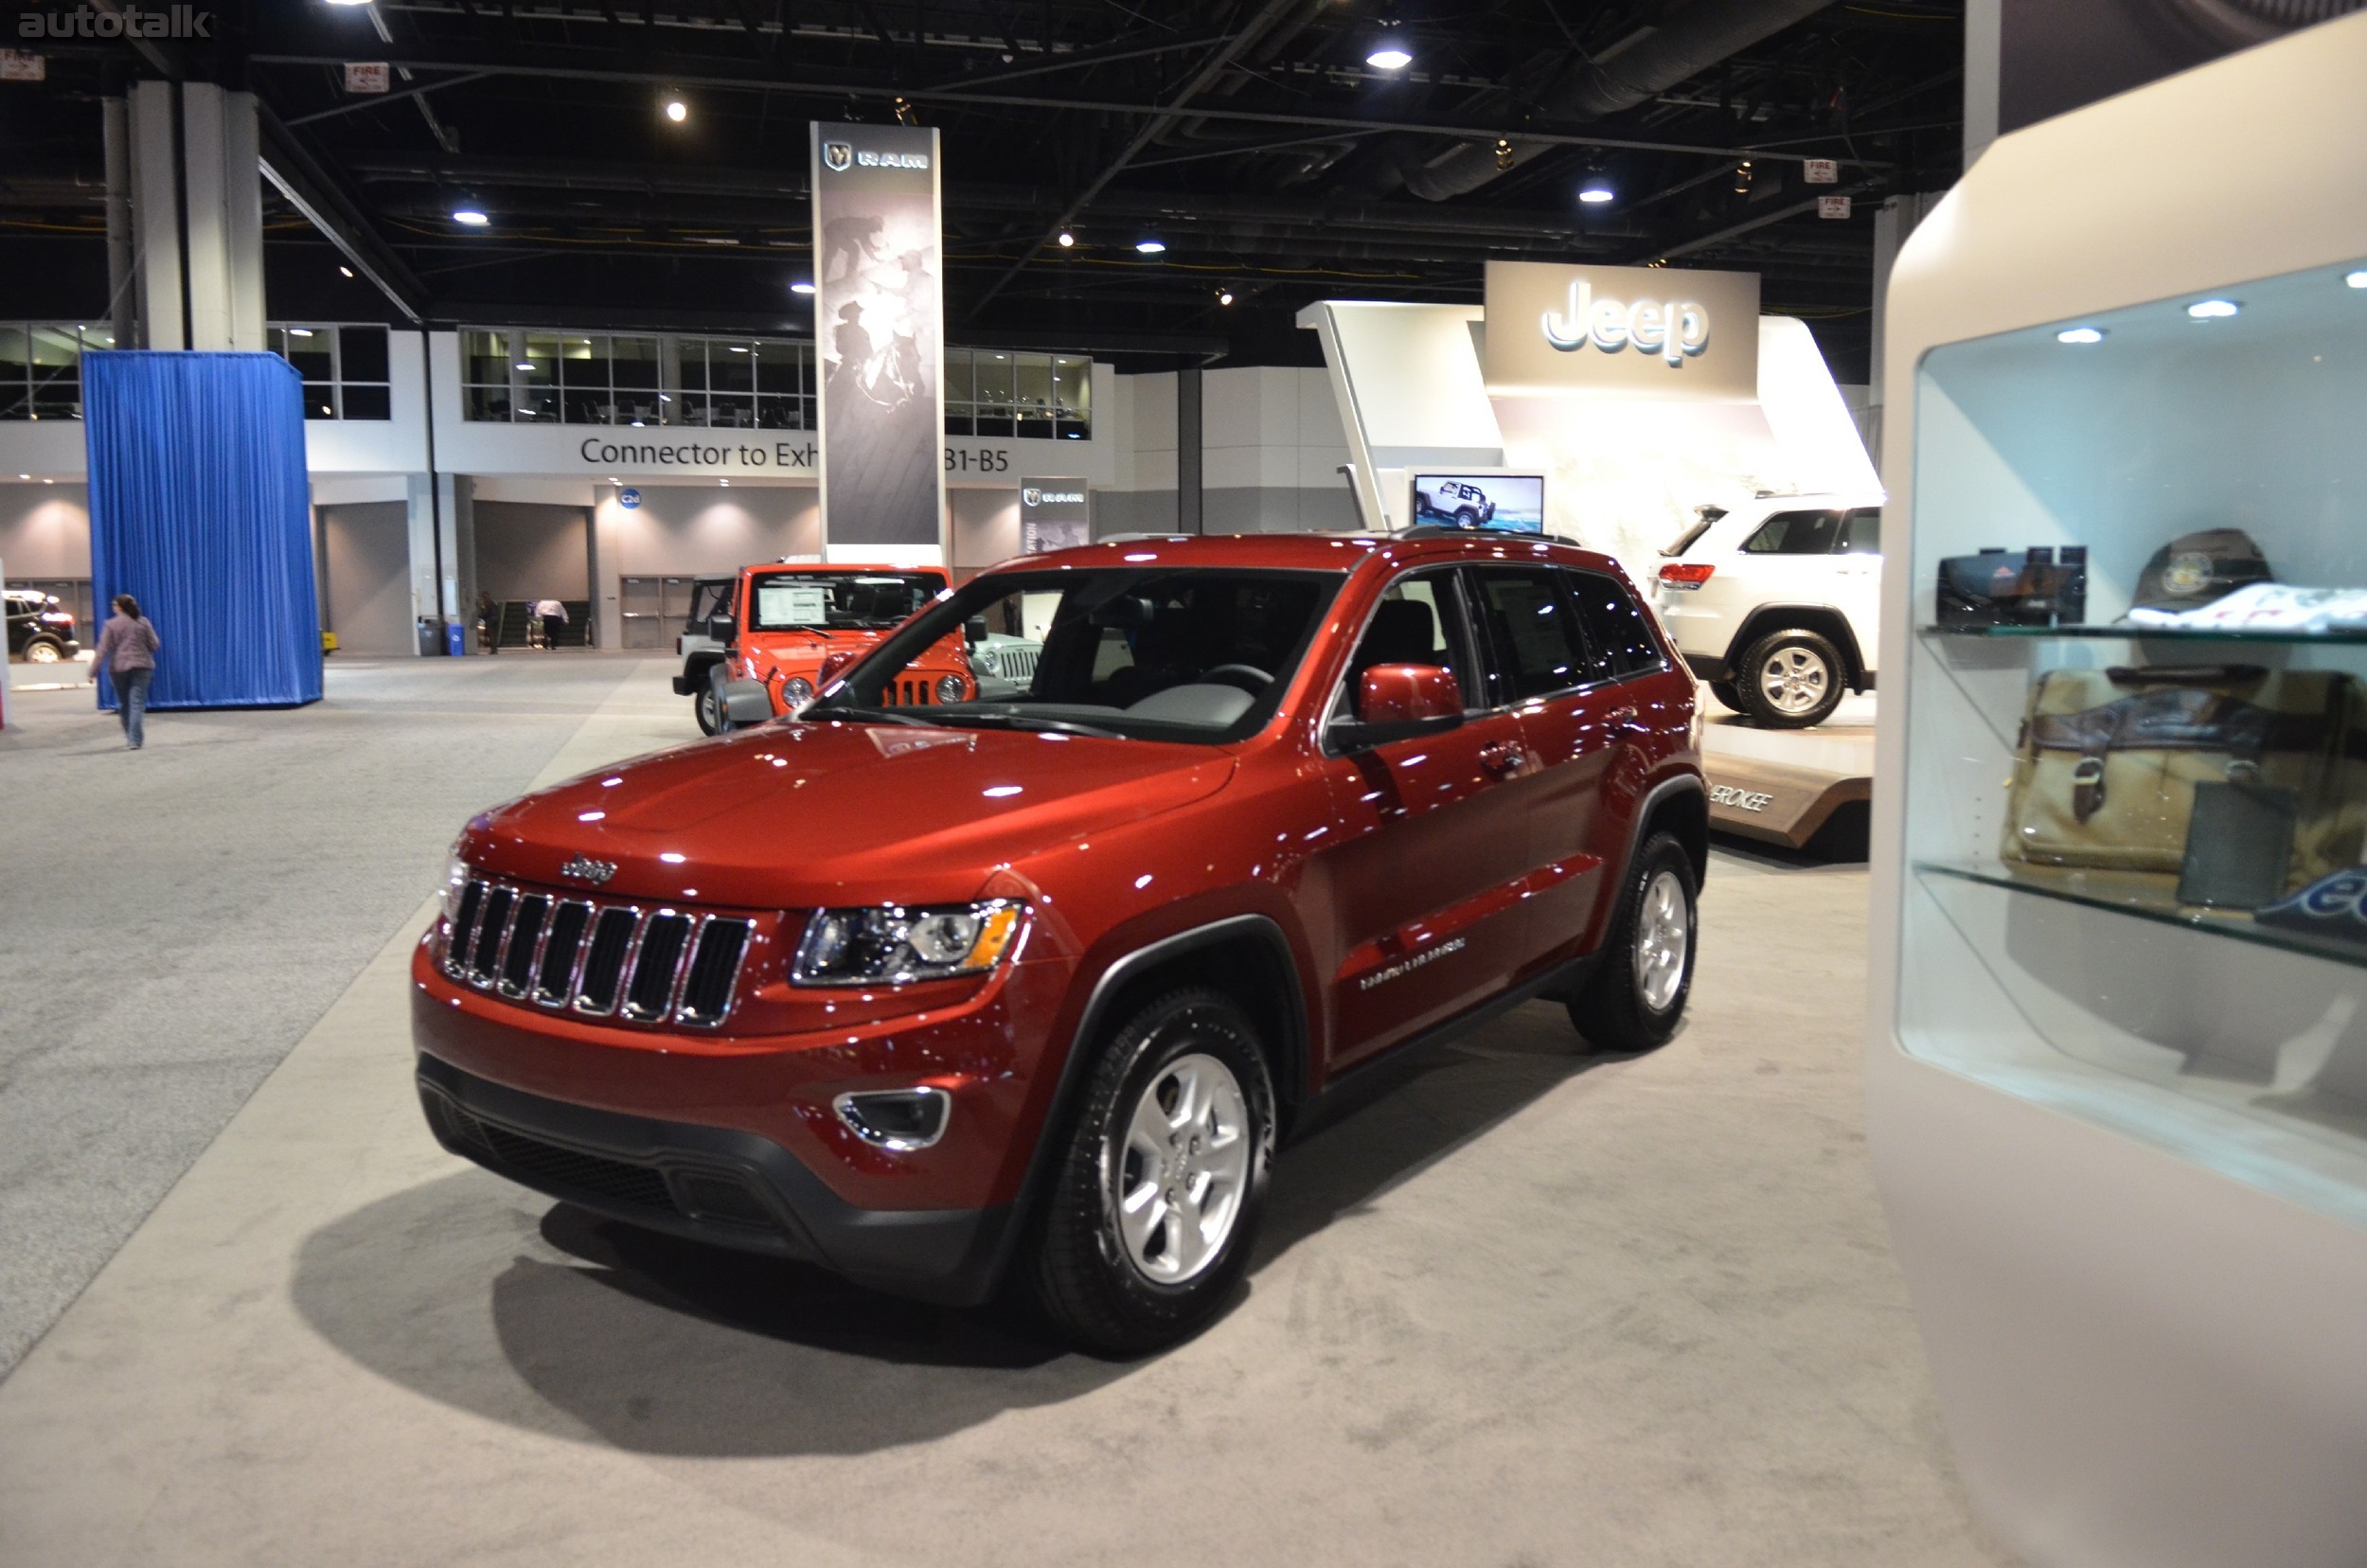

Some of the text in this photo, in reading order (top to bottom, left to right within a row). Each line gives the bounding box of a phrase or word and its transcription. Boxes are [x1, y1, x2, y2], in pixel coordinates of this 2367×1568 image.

[353, 66, 380, 75] FIRE
[858, 151, 928, 169] RAM
[1810, 161, 1831, 169] FIRE
[1824, 197, 1845, 205] FIRE
[1542, 281, 1710, 368] Jeep
[580, 437, 731, 465] Connector
[739, 444, 767, 467] to
[1709, 784, 1773, 811] EROKEE
